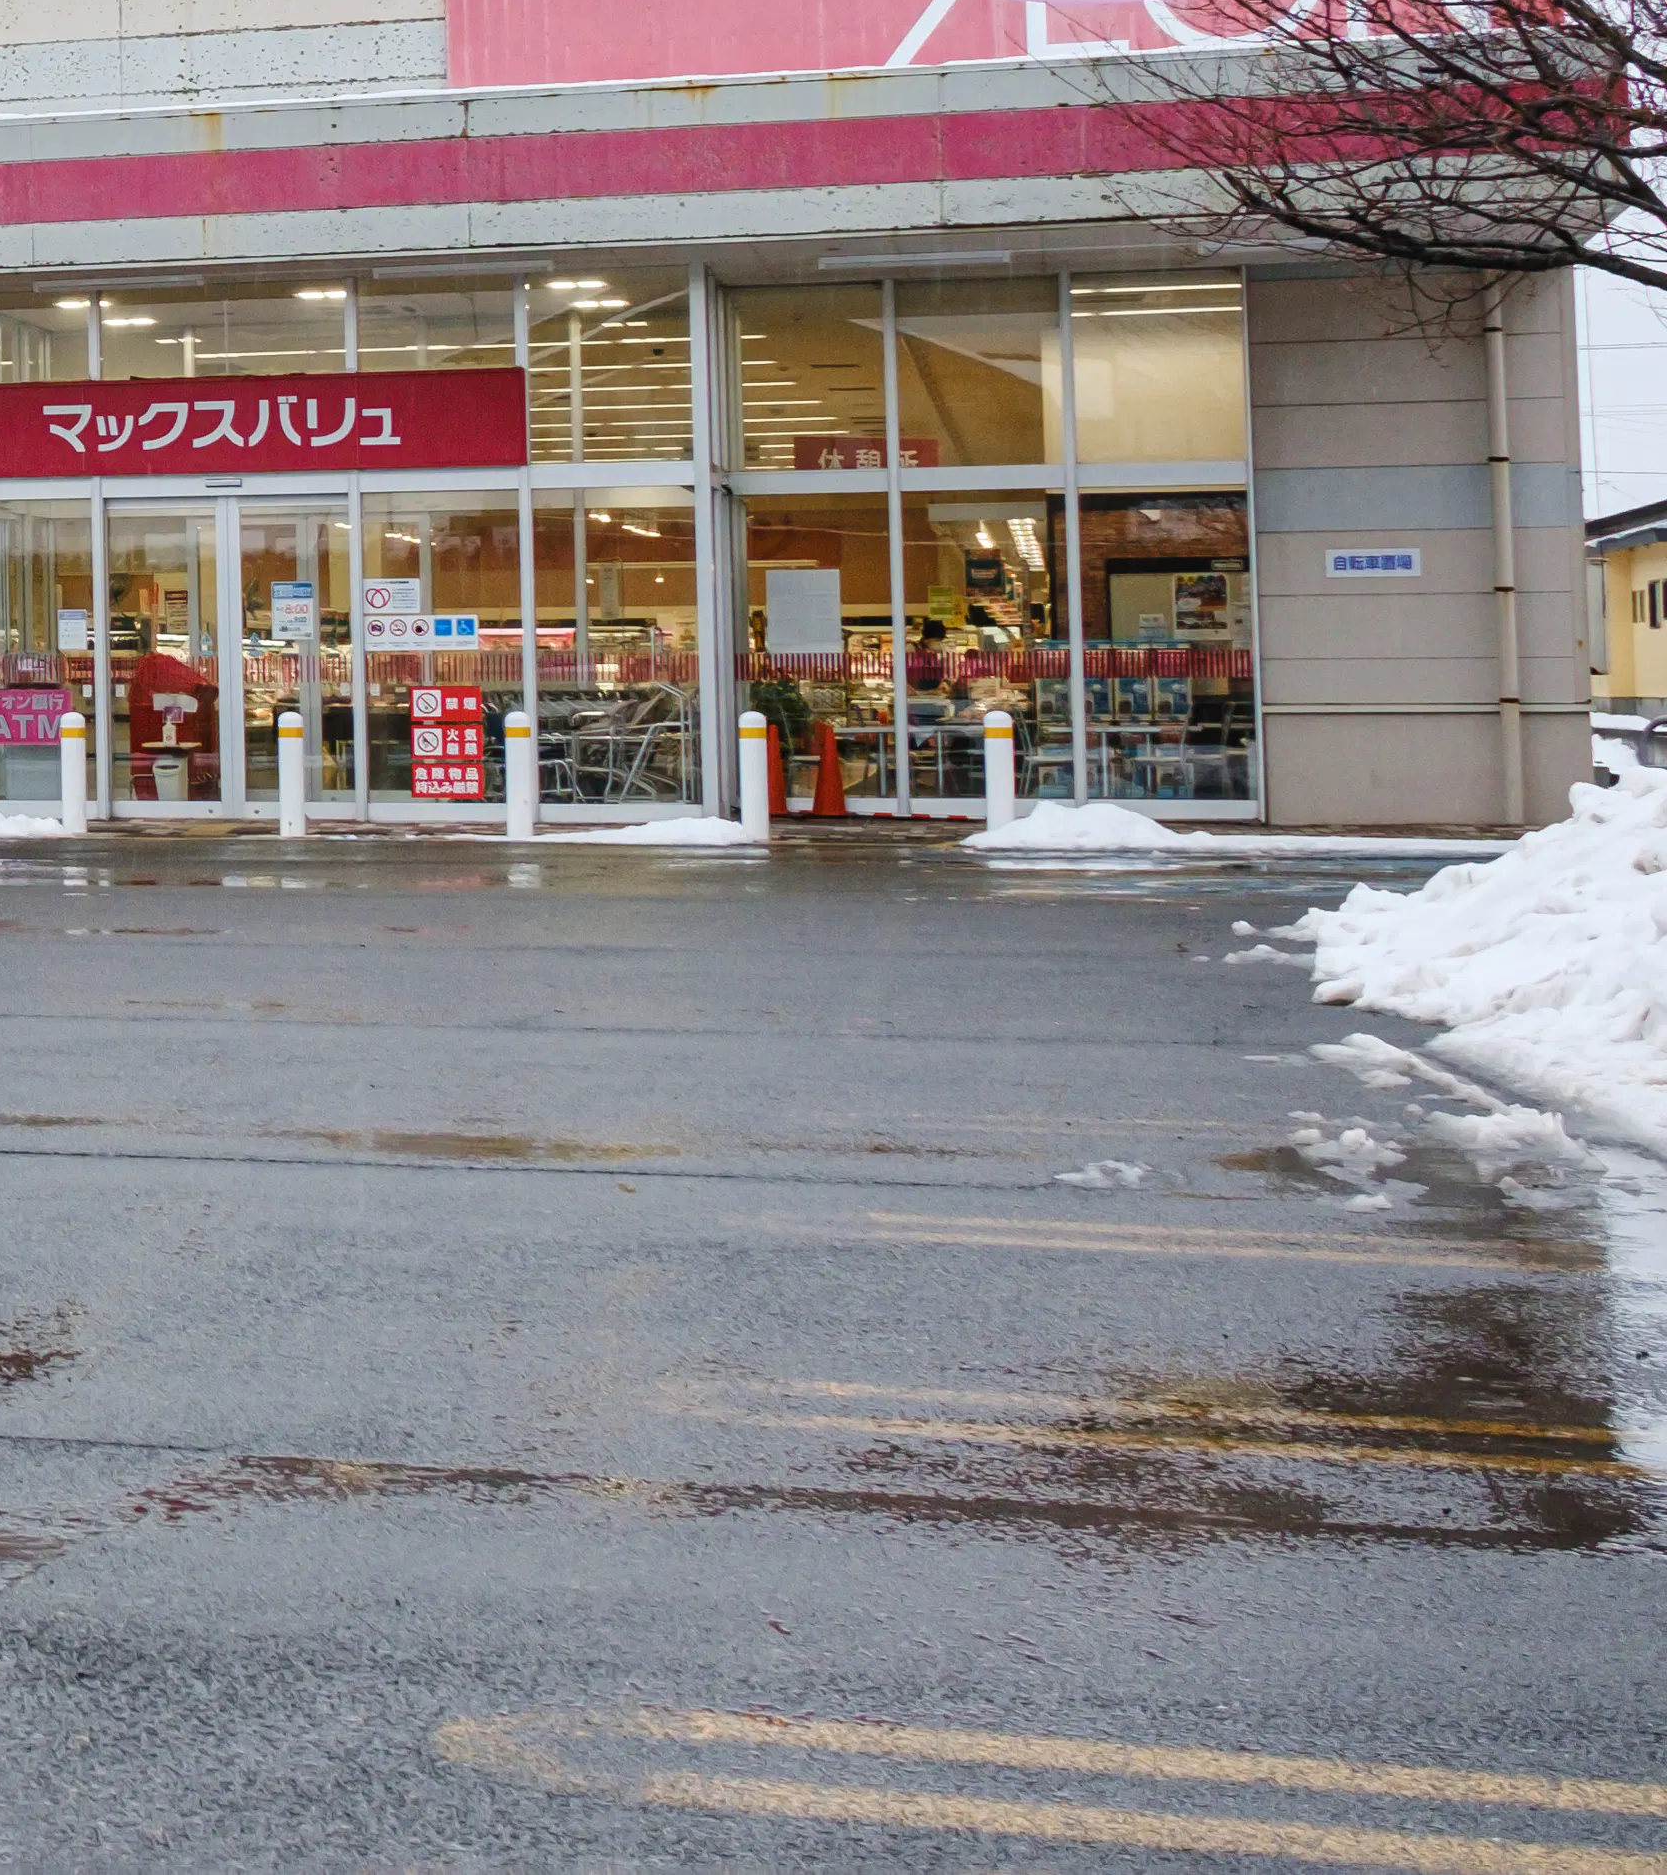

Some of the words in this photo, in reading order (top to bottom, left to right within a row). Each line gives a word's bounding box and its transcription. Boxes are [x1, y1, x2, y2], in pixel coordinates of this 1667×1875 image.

[42, 395, 402, 453] マックスバリュ
